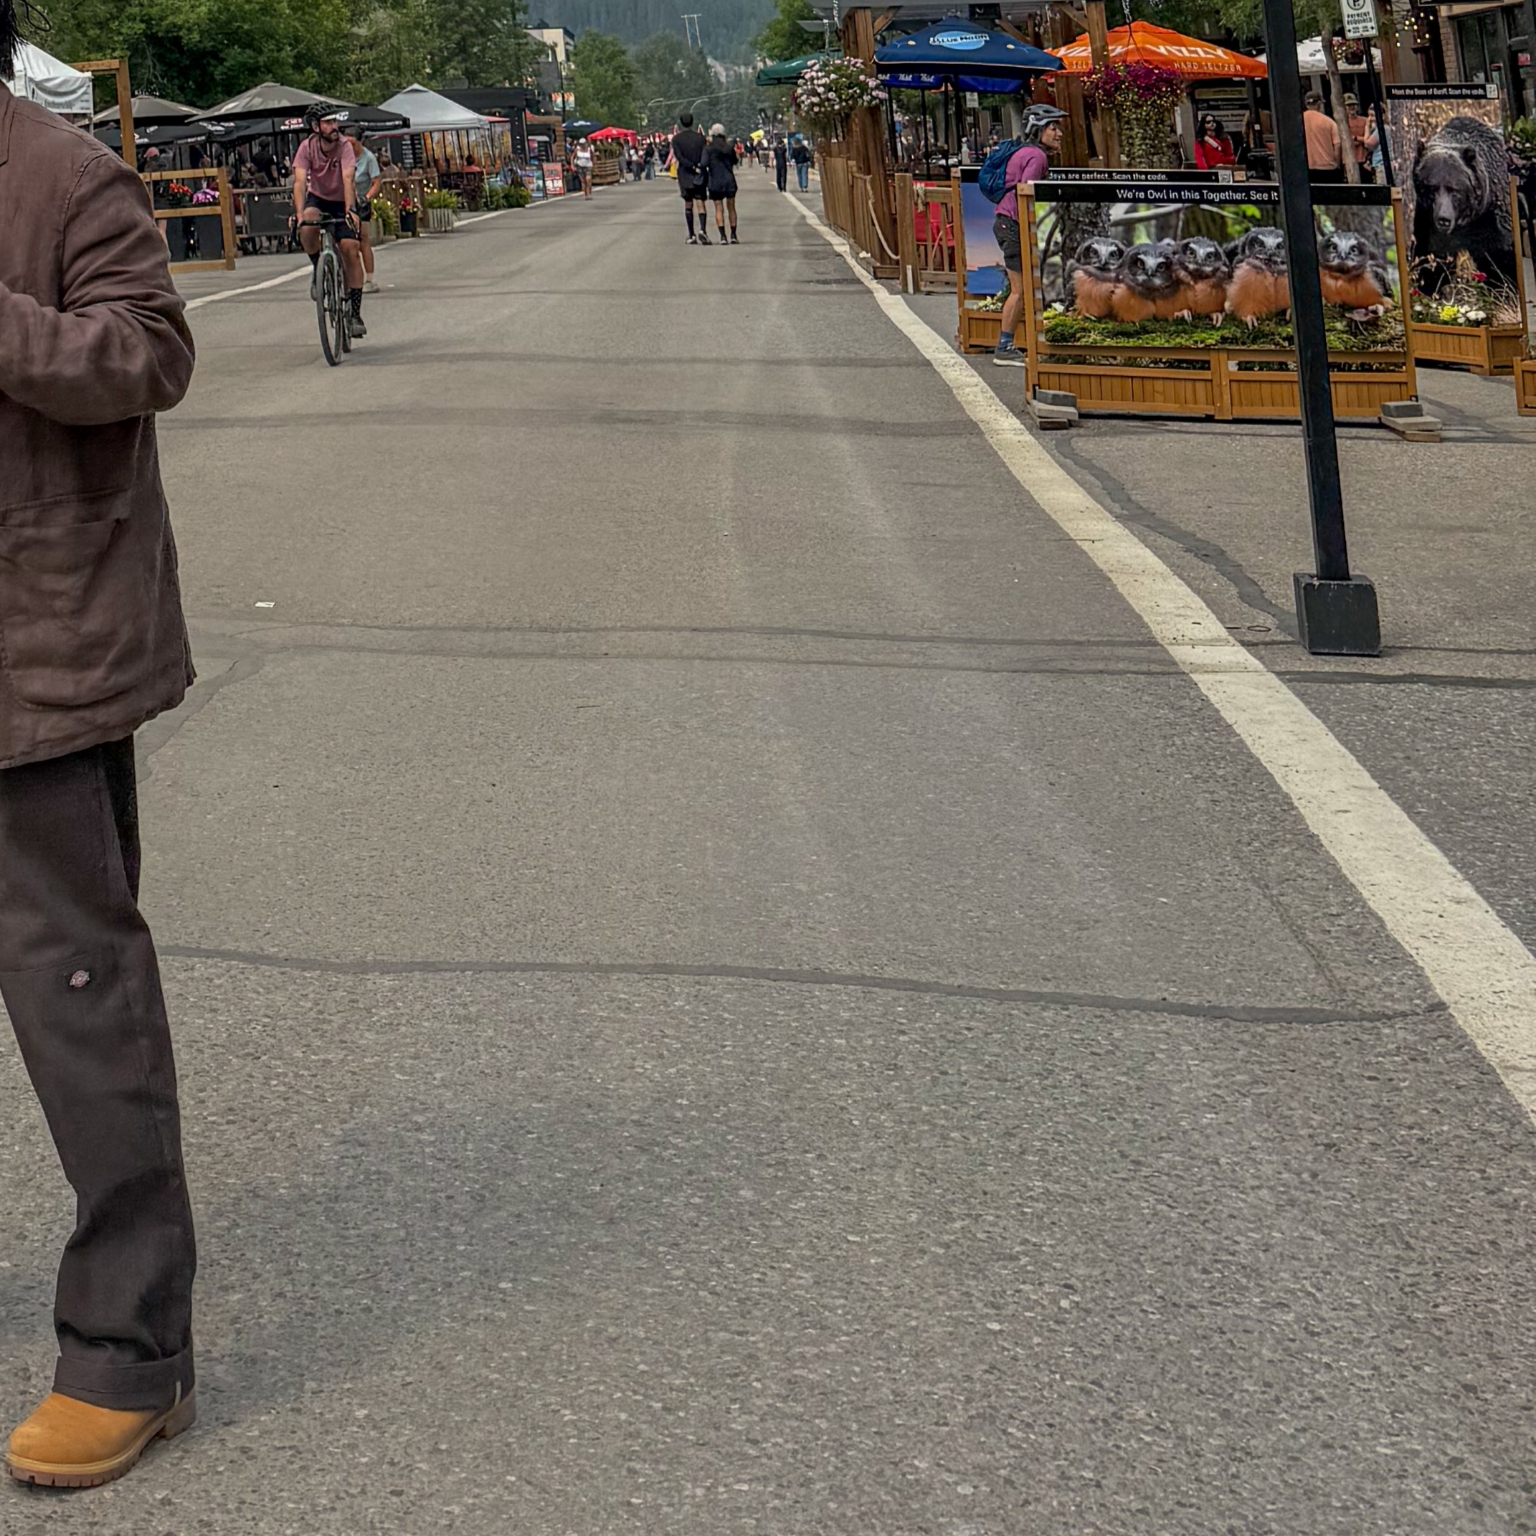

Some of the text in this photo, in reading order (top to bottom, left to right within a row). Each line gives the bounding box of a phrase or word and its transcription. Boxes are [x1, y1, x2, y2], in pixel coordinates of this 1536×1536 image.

[1145, 44, 1230, 60] VIZZY
[1174, 61, 1242, 72] HARD SELTZER
[1081, 172, 1112, 182] perfect.
[1112, 172, 1132, 181] Scan
[1132, 172, 1147, 181] the
[1116, 188, 1279, 202] We're Owl in this Together. See it
